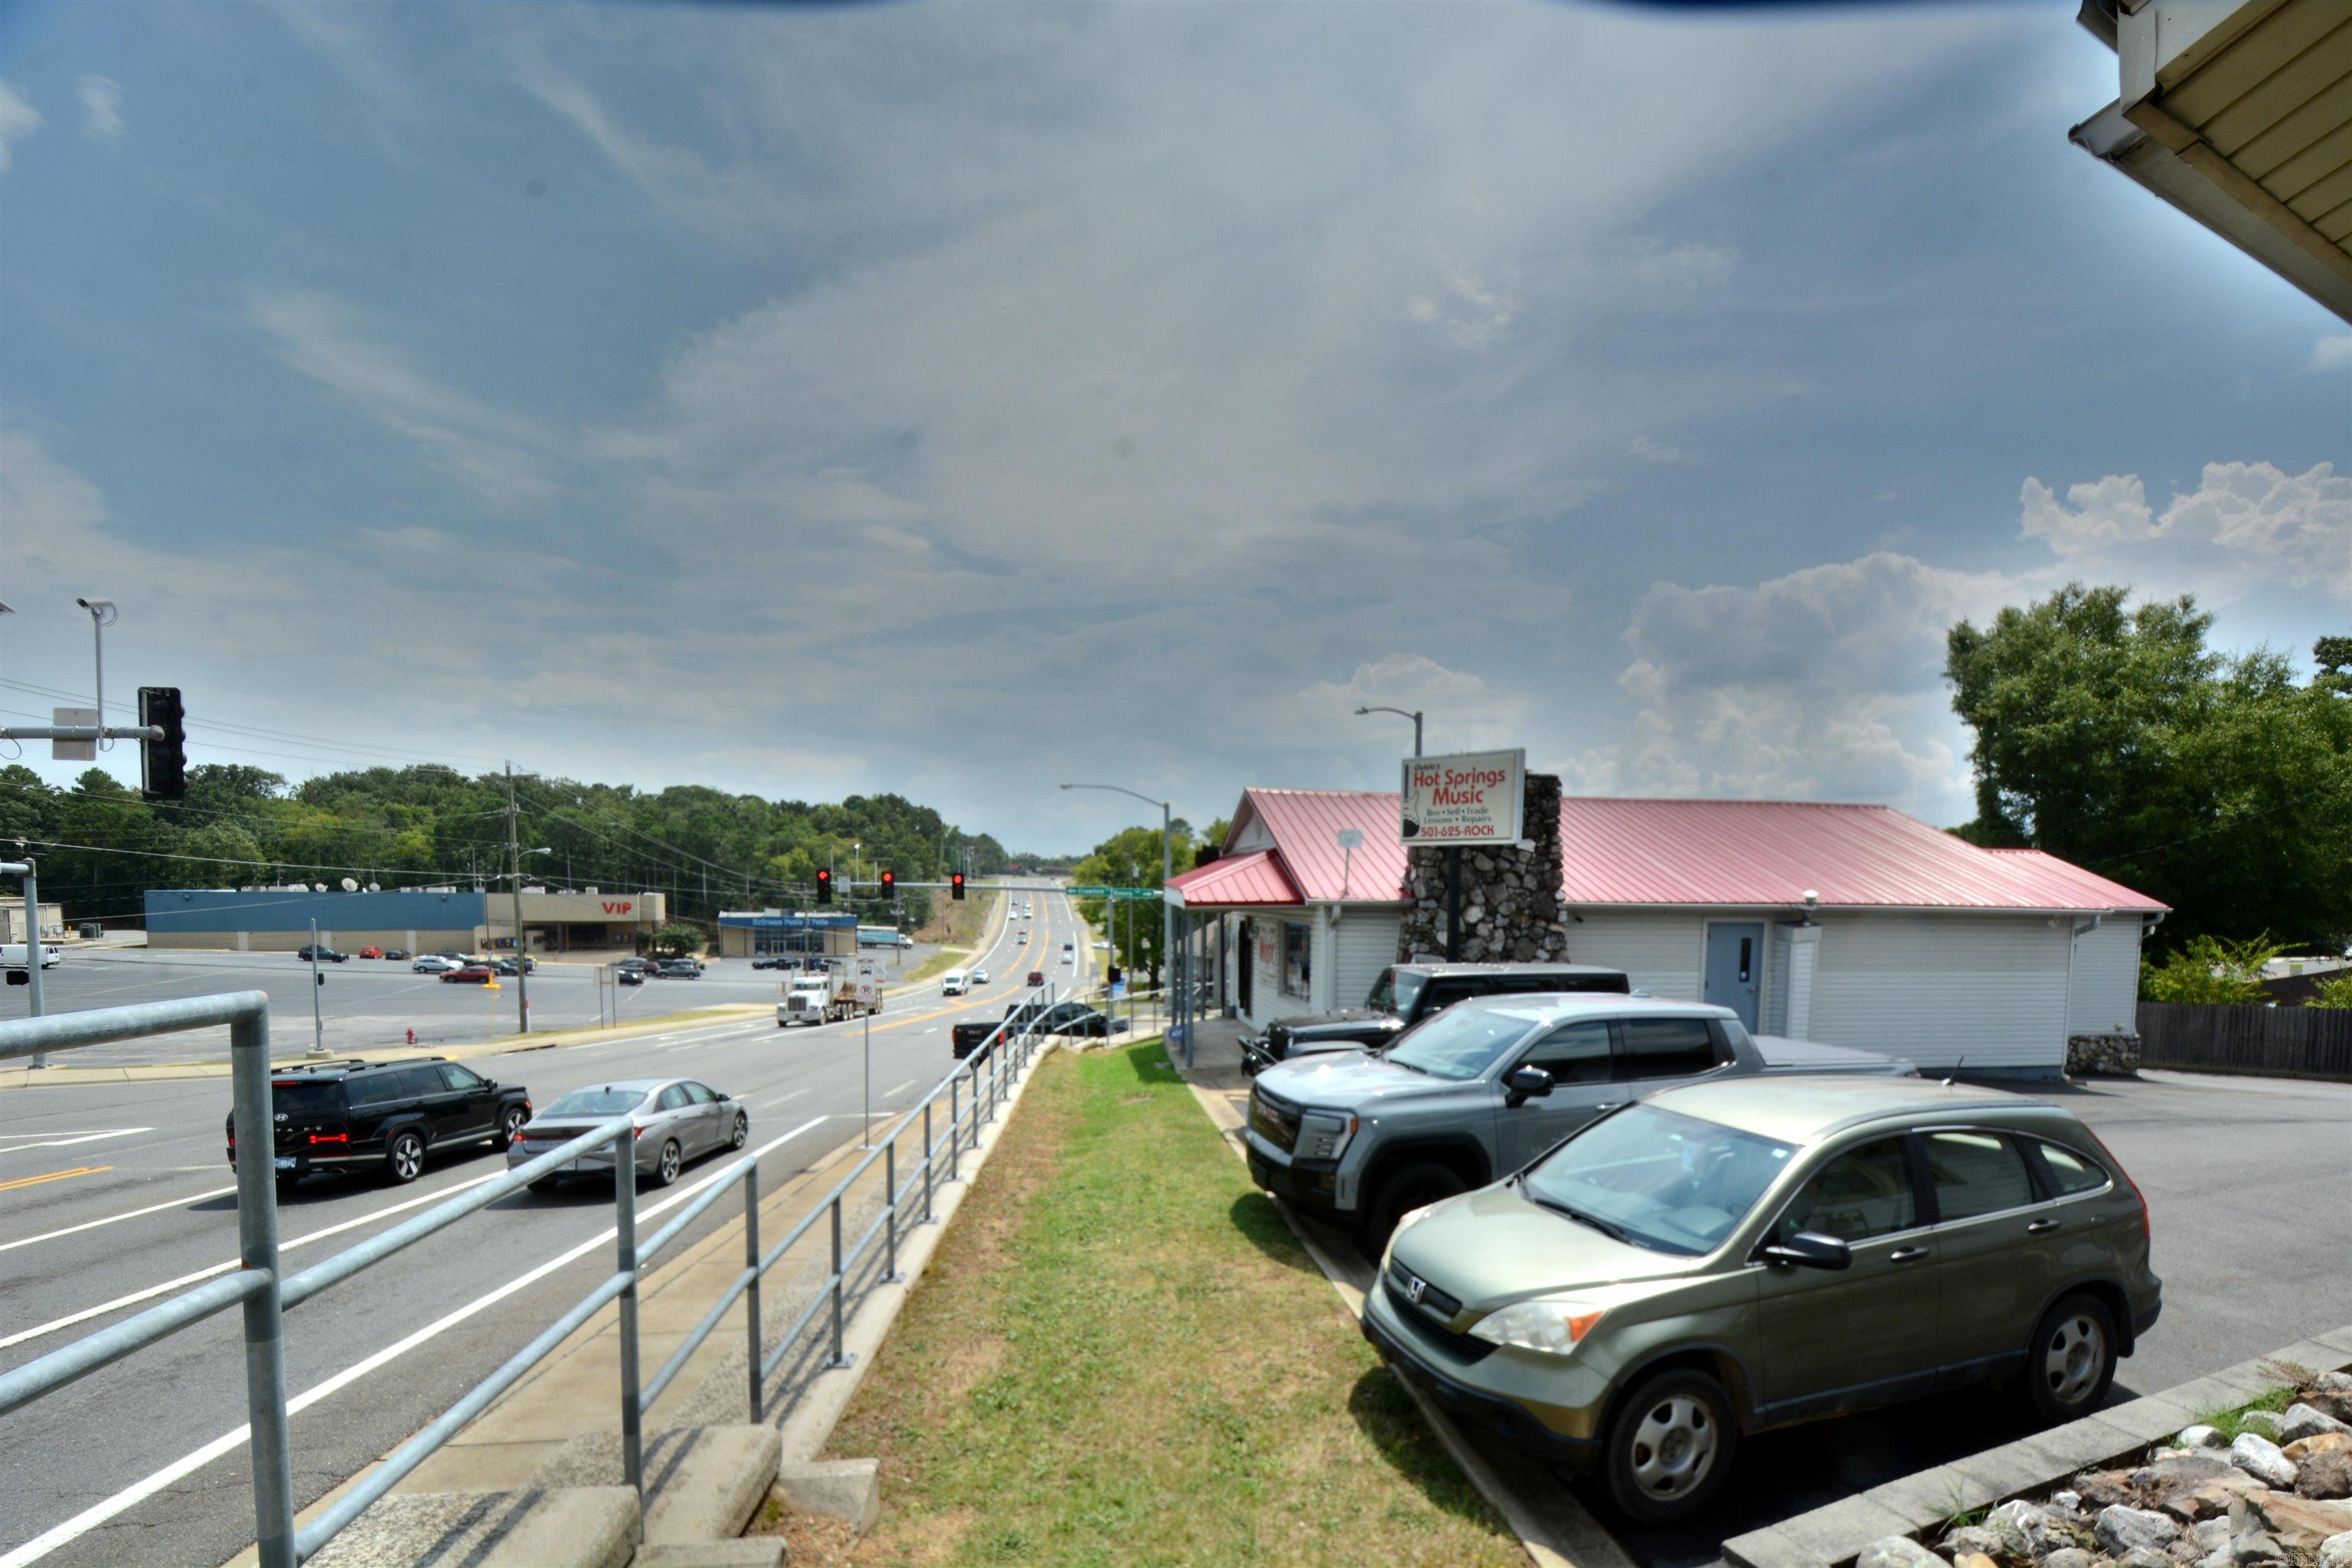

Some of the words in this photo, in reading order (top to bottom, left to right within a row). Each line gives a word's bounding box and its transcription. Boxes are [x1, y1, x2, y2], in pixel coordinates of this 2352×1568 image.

[1414, 771, 1440, 788] Hot
[1445, 767, 1506, 789] Springs
[1432, 785, 1484, 805] Music
[1426, 808, 1440, 817] Buy
[1446, 807, 1460, 815] Sell
[1467, 806, 1489, 815] Trade
[1424, 816, 1452, 825] Lessons
[1462, 815, 1492, 825] Repairs
[1421, 825, 1494, 838] 501-625-ROCK
[602, 902, 632, 915] VIP
